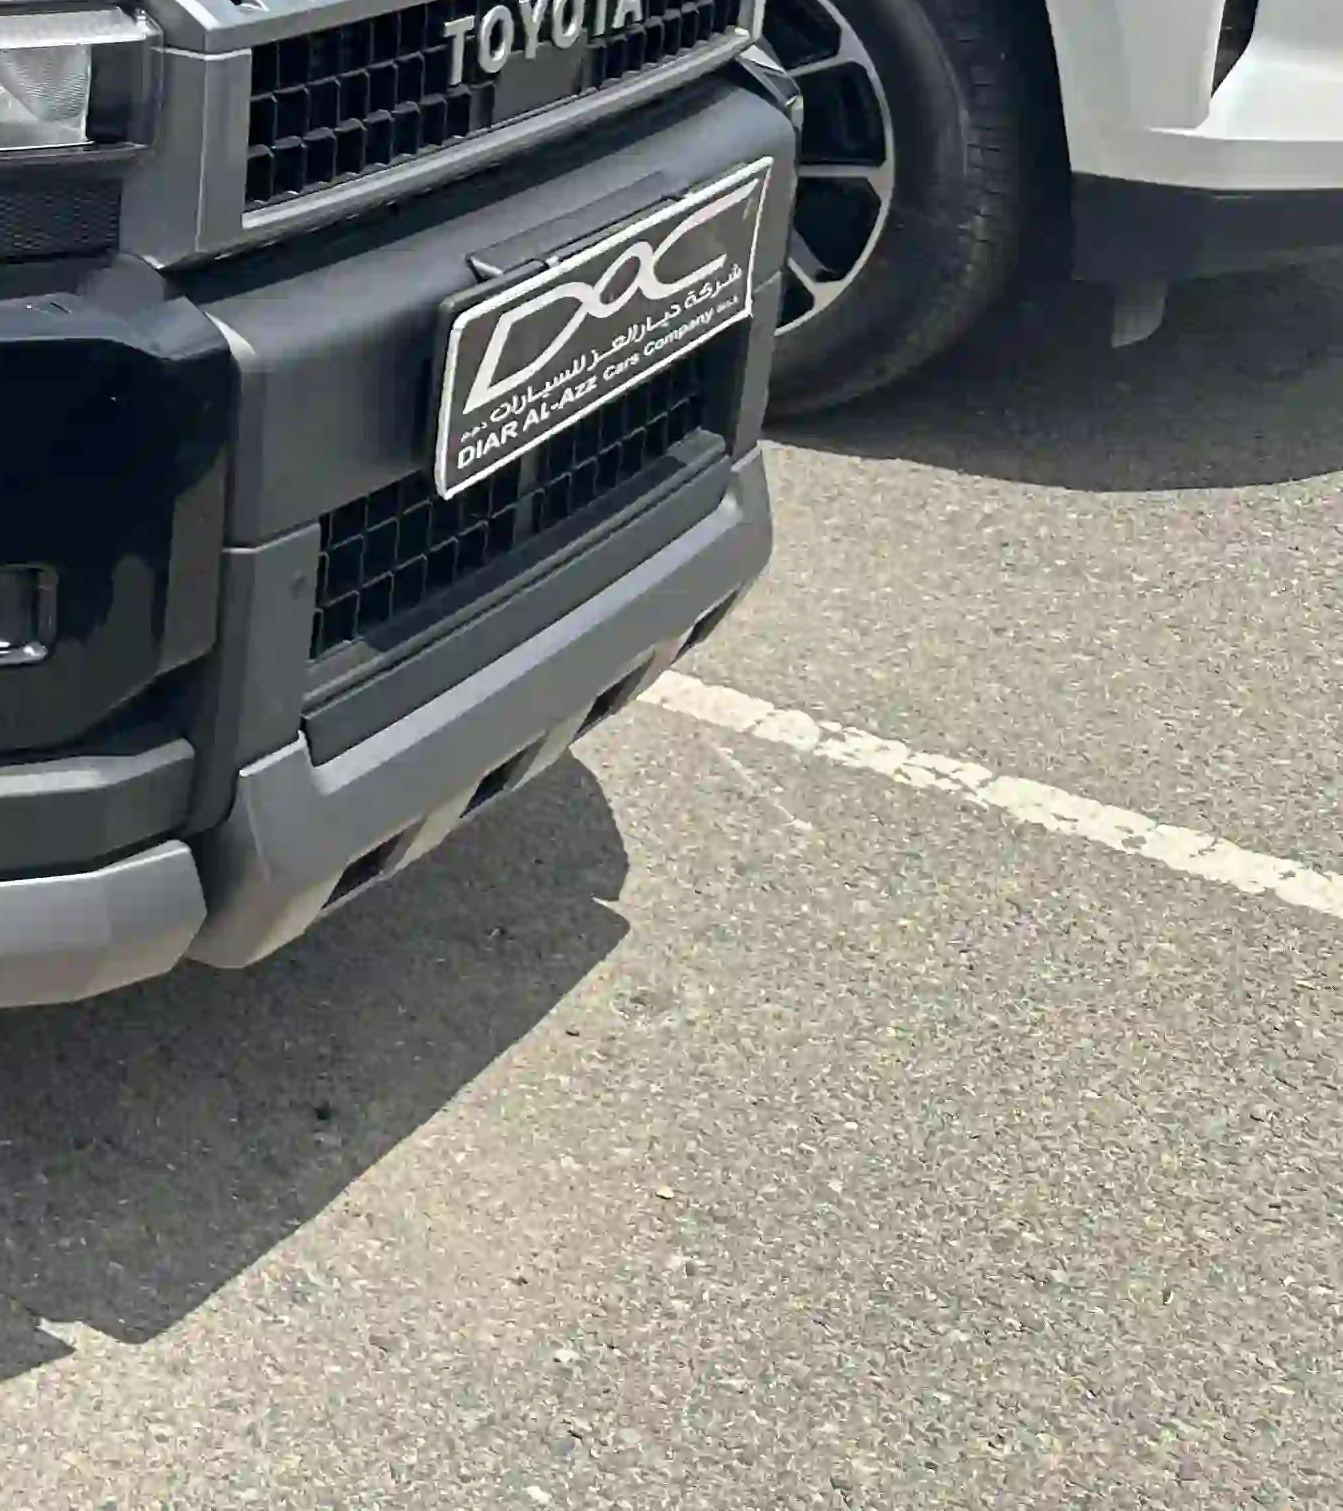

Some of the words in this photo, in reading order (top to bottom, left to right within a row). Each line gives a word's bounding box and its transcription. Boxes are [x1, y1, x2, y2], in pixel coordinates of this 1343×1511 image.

[683, 262, 743, 309] شركة
[456, 420, 520, 470] DIAR
[602, 354, 640, 382] Cars
[643, 306, 714, 358] Company
[489, 353, 587, 423] للسيارات
